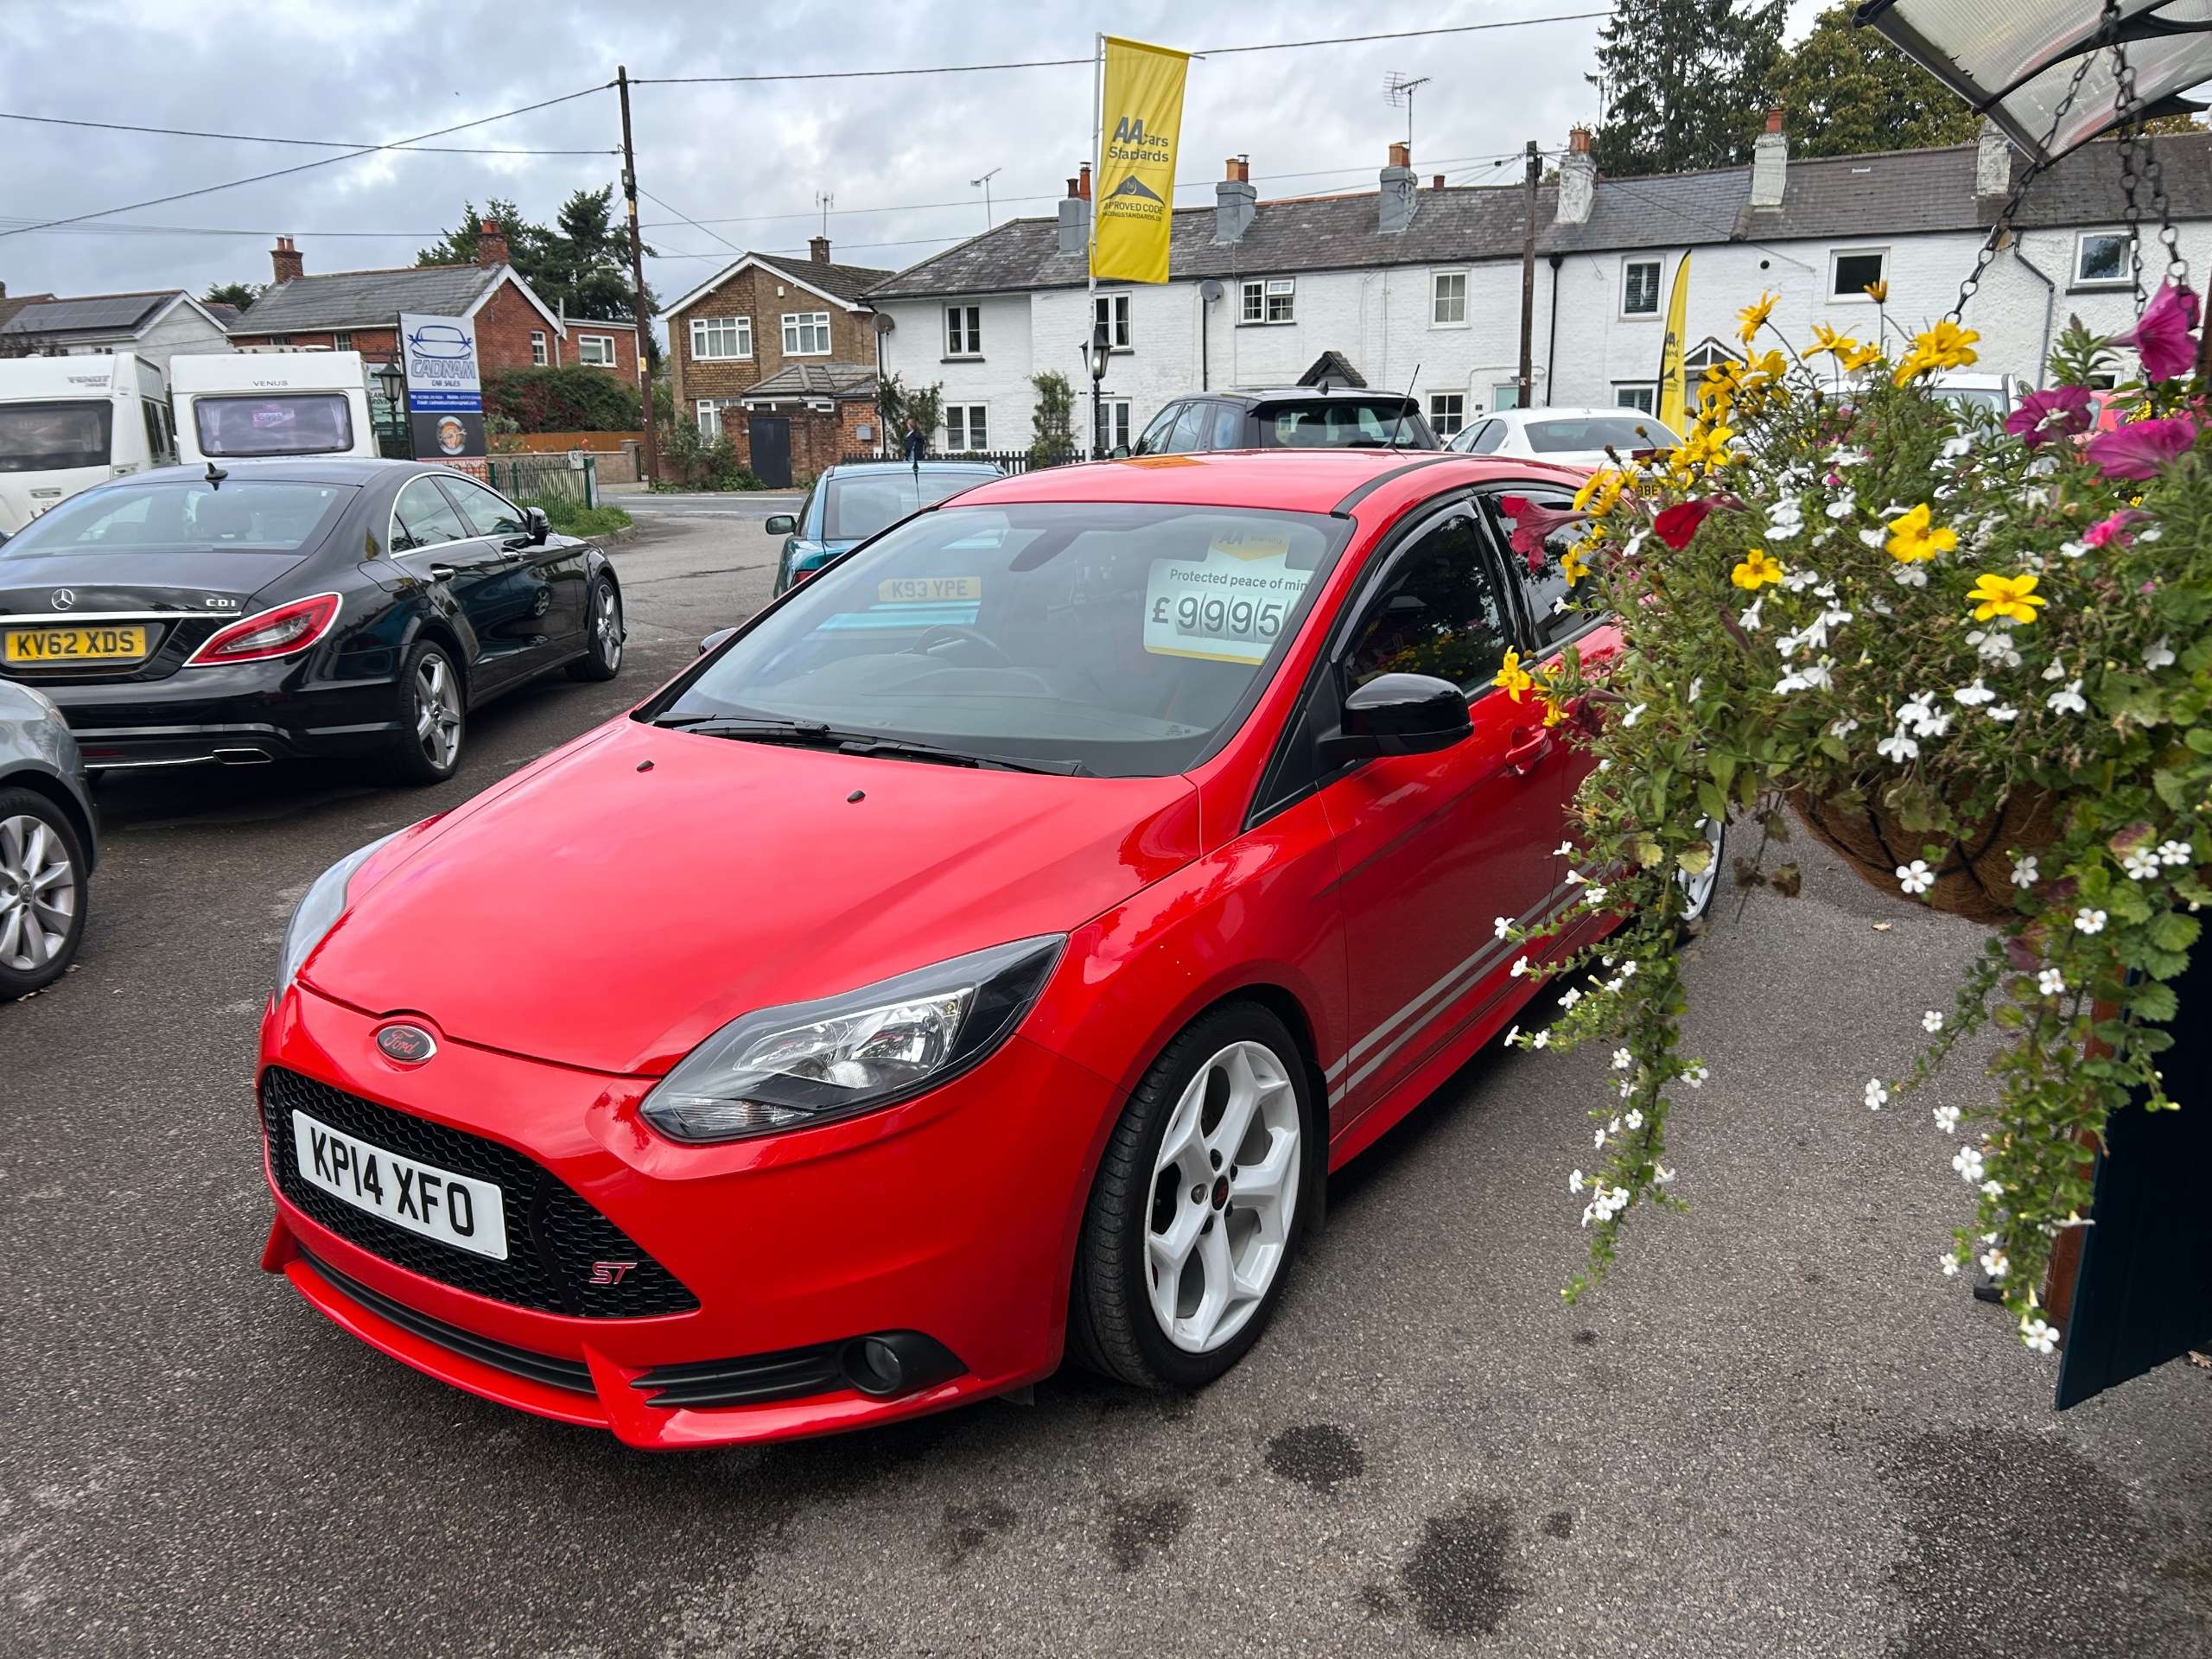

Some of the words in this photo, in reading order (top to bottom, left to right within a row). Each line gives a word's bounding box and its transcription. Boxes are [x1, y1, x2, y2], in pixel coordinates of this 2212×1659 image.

[1142, 204, 1164, 215] CODE
[410, 359, 476, 379] CADNAM
[891, 580, 928, 598] K93
[933, 579, 969, 596] YPE
[1169, 568, 1228, 585] Protected
[1230, 575, 1267, 588] peace
[1269, 578, 1286, 589] of
[1284, 581, 1308, 592] min
[206, 598, 237, 607] CDI
[1152, 596, 1283, 638] £9995
[16, 632, 78, 658] KV62
[86, 630, 135, 654] XDS
[383, 1029, 421, 1055] Ford
[310, 1126, 385, 1205] KP14
[391, 1161, 475, 1238] XFO
[588, 1262, 638, 1285] ST
